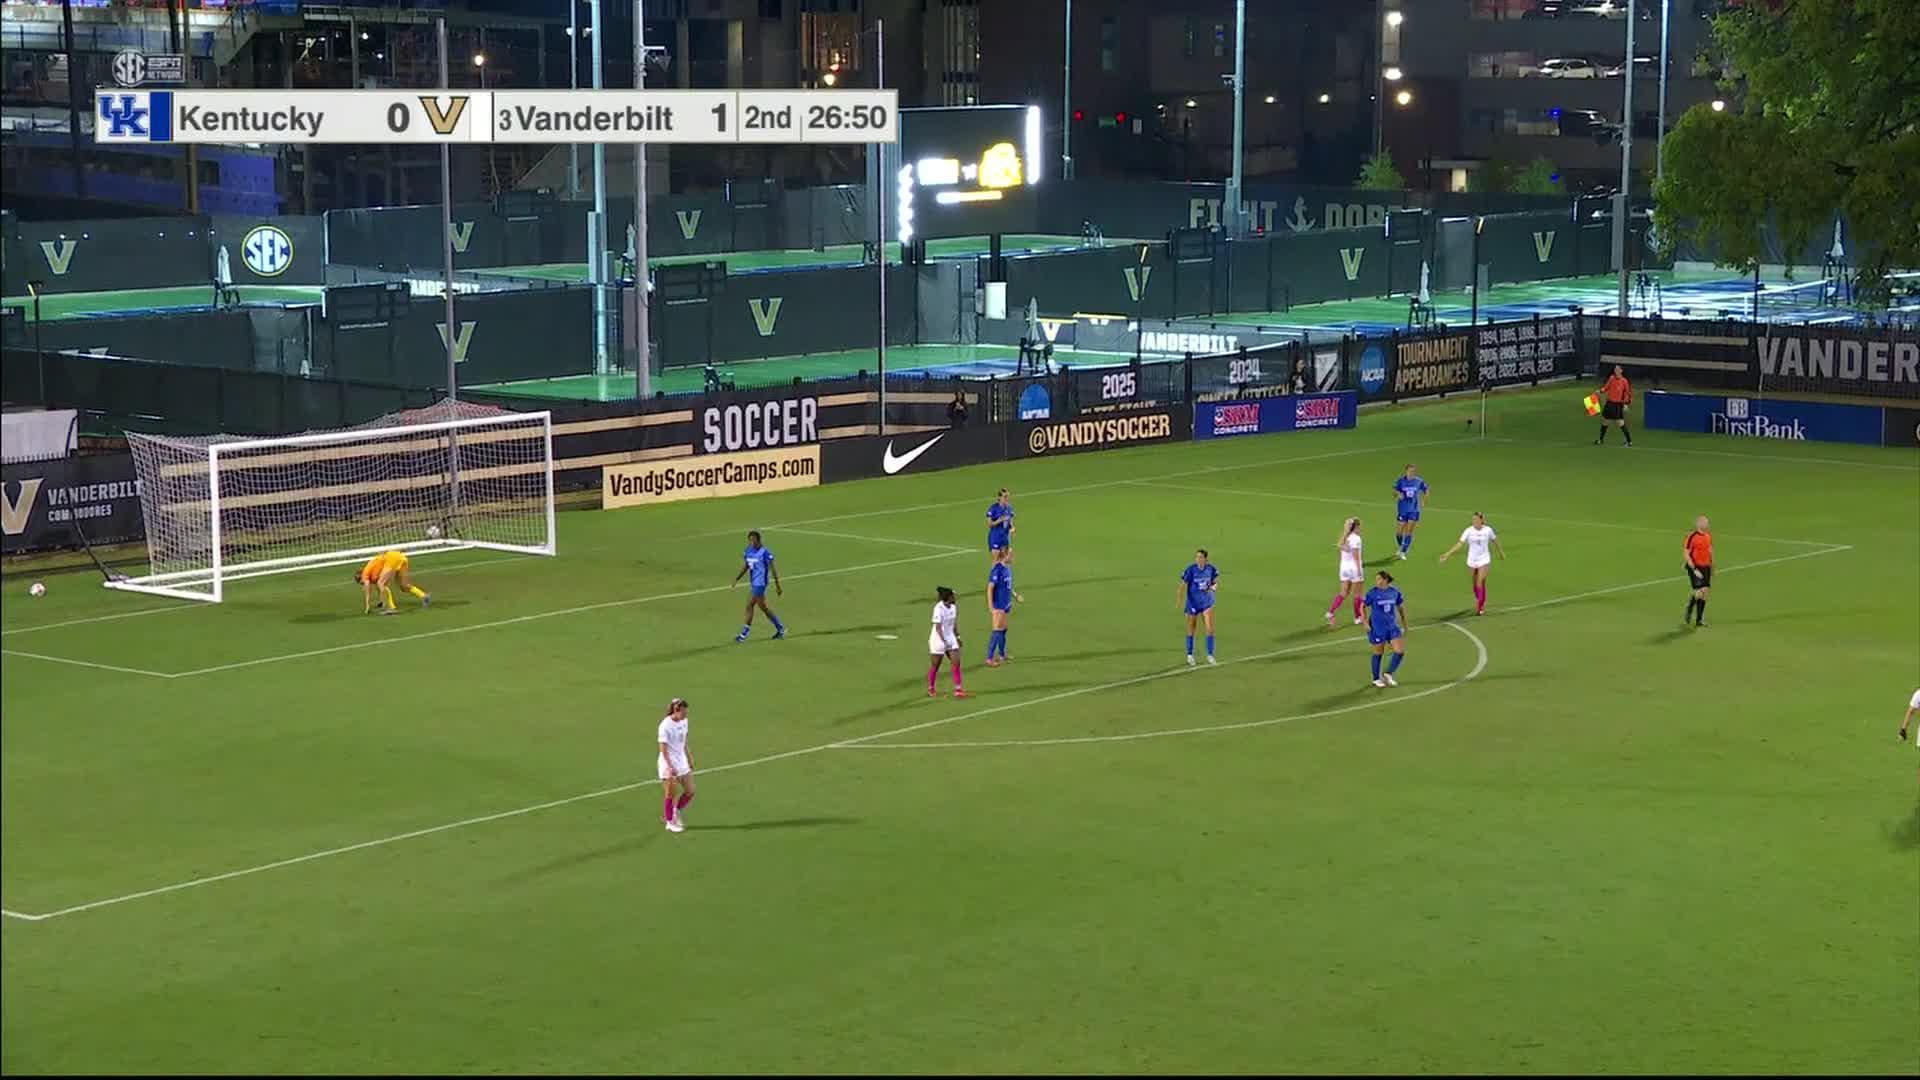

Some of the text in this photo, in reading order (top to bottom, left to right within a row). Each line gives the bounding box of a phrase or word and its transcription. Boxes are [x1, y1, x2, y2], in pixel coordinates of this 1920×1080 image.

[1190, 198, 1278, 231] FIHT
[246, 228, 290, 274] SEC
[1397, 335, 1468, 365] TOURNAMENT
[1102, 372, 1136, 399] 2025
[1230, 358, 1260, 384] 2024
[1361, 369, 1385, 382] NCAA
[1394, 361, 1469, 393] APPEARANCES
[704, 398, 818, 453] SOCCER
[1029, 414, 1171, 453] @VANDYSOCCER
[1213, 425, 1258, 435] CONCRETE
[1295, 418, 1338, 428] CONCRETE
[1712, 412, 1806, 440] FirstBank
[610, 456, 815, 496] VandySoccerCamps.com
